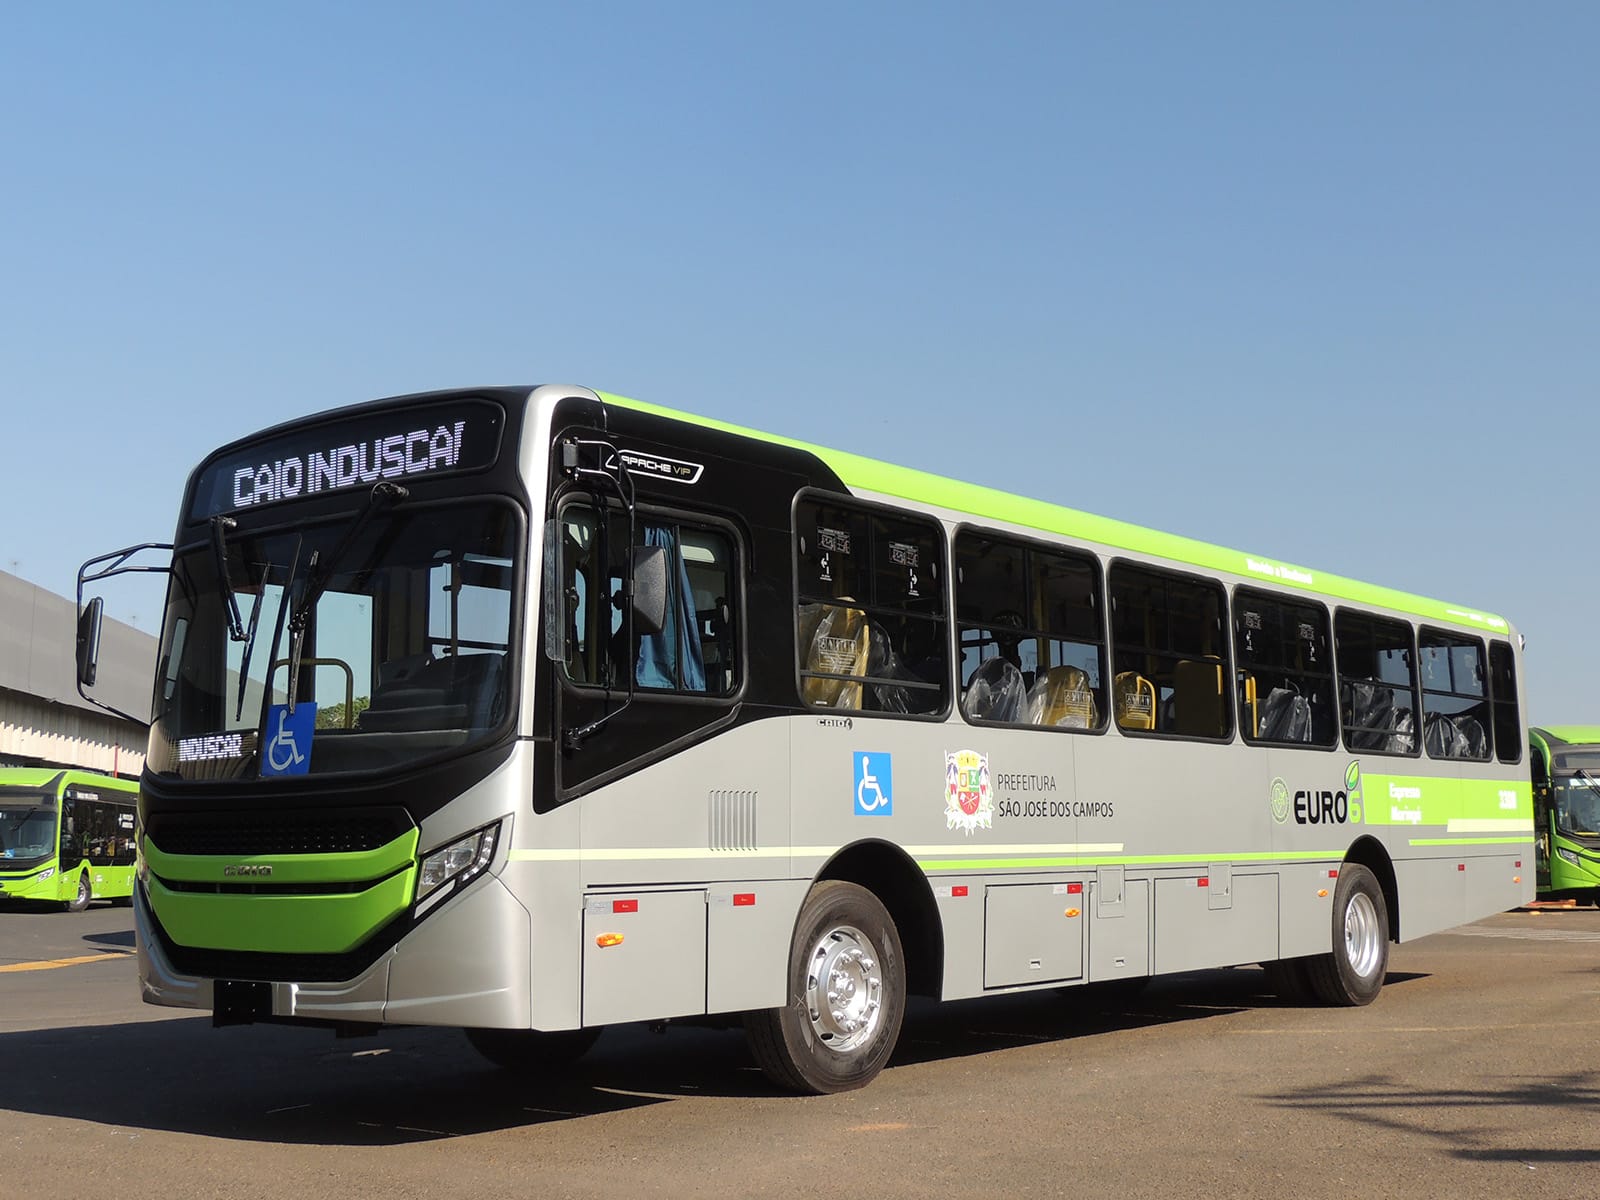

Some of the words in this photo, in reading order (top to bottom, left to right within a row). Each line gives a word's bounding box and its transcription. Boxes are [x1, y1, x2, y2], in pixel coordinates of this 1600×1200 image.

[672, 465, 691, 476] VIP
[233, 457, 304, 507] CAIO
[997, 774, 1057, 792] PREFEITURA
[998, 798, 1021, 818] SÃO
[1023, 799, 1048, 818] JOSÉ
[1050, 801, 1071, 818] DOS
[1073, 802, 1114, 818] CAMPOS
